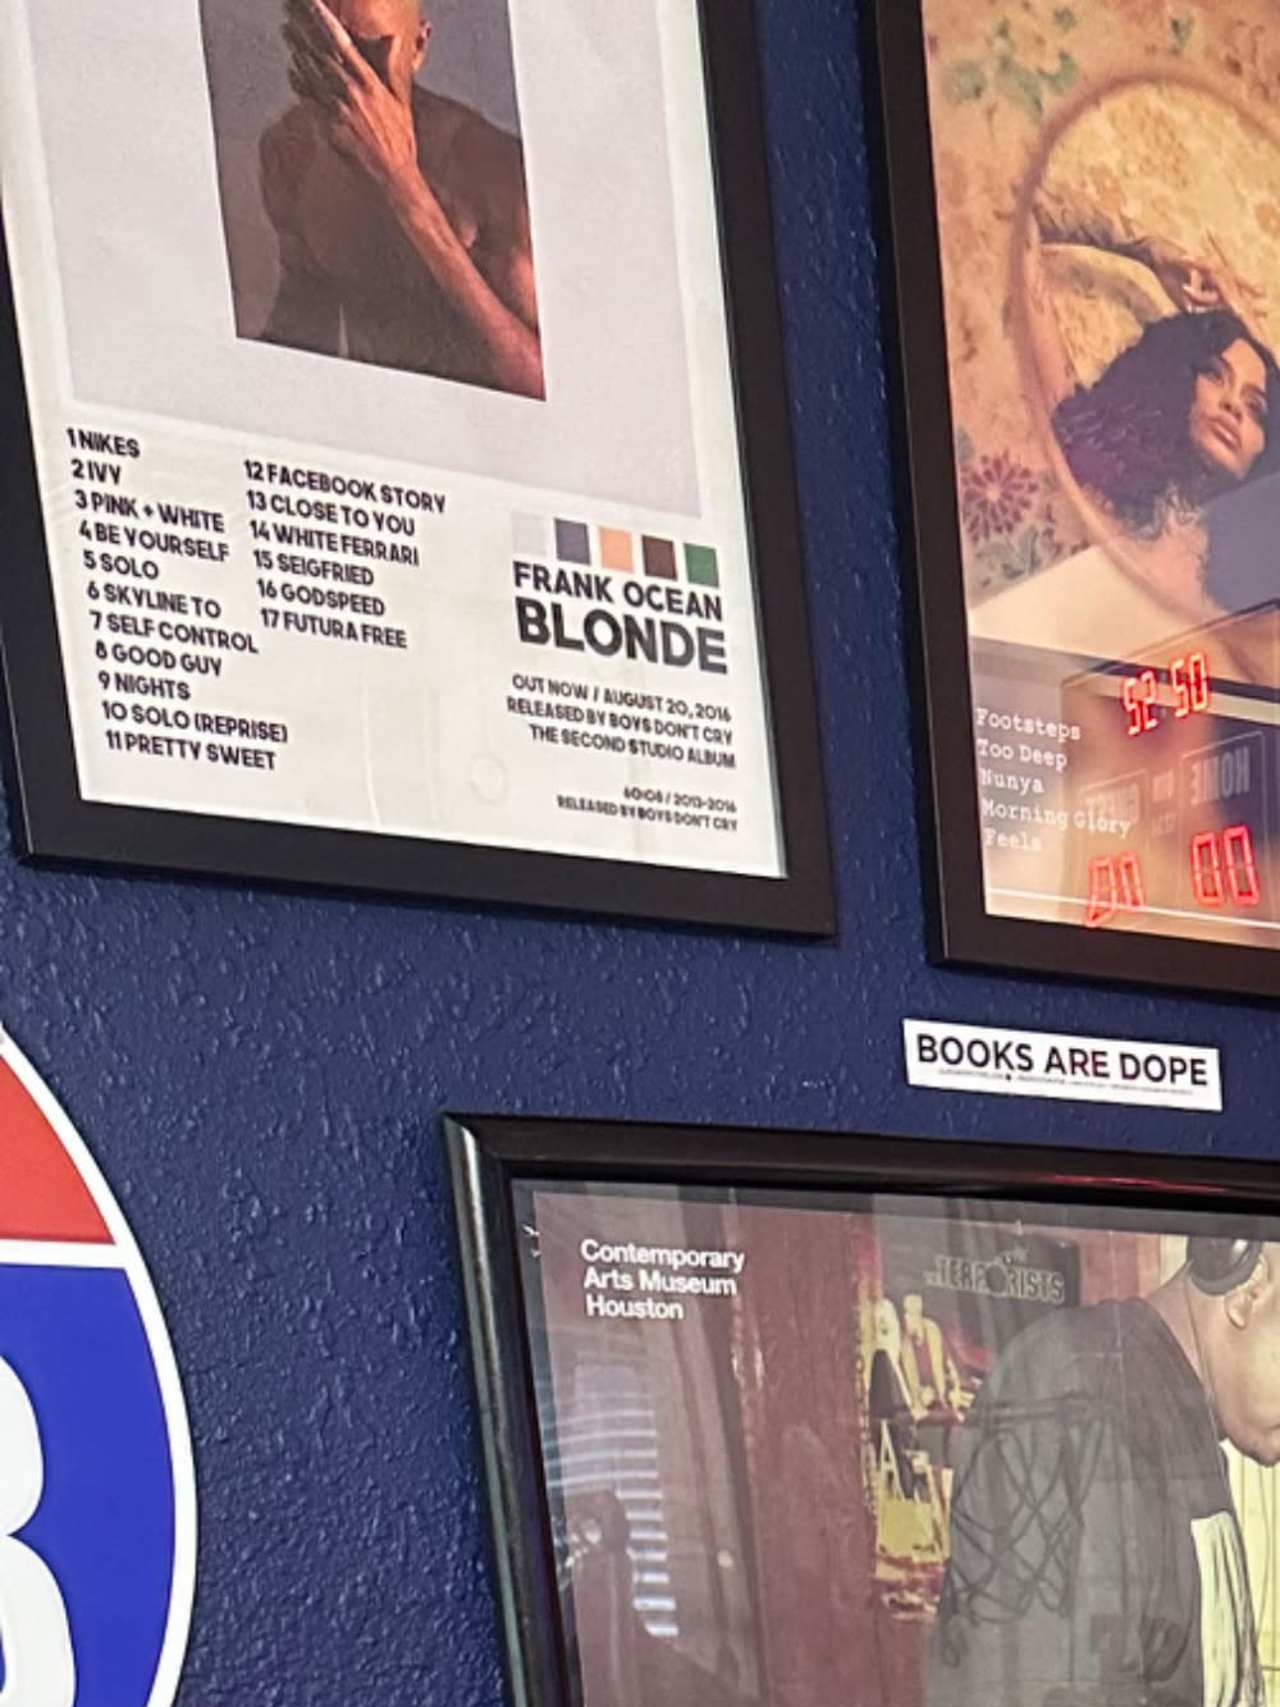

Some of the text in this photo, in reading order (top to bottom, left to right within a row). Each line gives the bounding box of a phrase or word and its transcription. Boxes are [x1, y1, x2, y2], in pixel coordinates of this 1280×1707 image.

[244, 460, 446, 513] 12 FACEBOOK STORY
[246, 491, 415, 536] 13 CLOSE TO YOU
[250, 521, 419, 566] 14 WHITE FERRARI
[253, 550, 374, 586] 15 SEIGFRIED
[87, 581, 221, 618] 6 SKYLINE TO
[257, 580, 385, 616] 16 GODSPEED
[513, 561, 722, 621] FRANK OCEAN
[89, 611, 259, 653] 7 SELF CONTROL
[261, 608, 407, 649] 17 FUTURA FREE
[516, 596, 727, 674] BLONDE
[976, 707, 1081, 742] Footsteps
[978, 738, 1067, 771] Too Deep
[916, 1033, 1033, 1072] BOOKS
[1045, 1047, 1110, 1078] ARE
[1120, 1053, 1208, 1086] DOPE
[581, 1238, 744, 1273] Contemporary
[583, 1268, 737, 1296] Arts Museum
[586, 1295, 684, 1319] Houston
